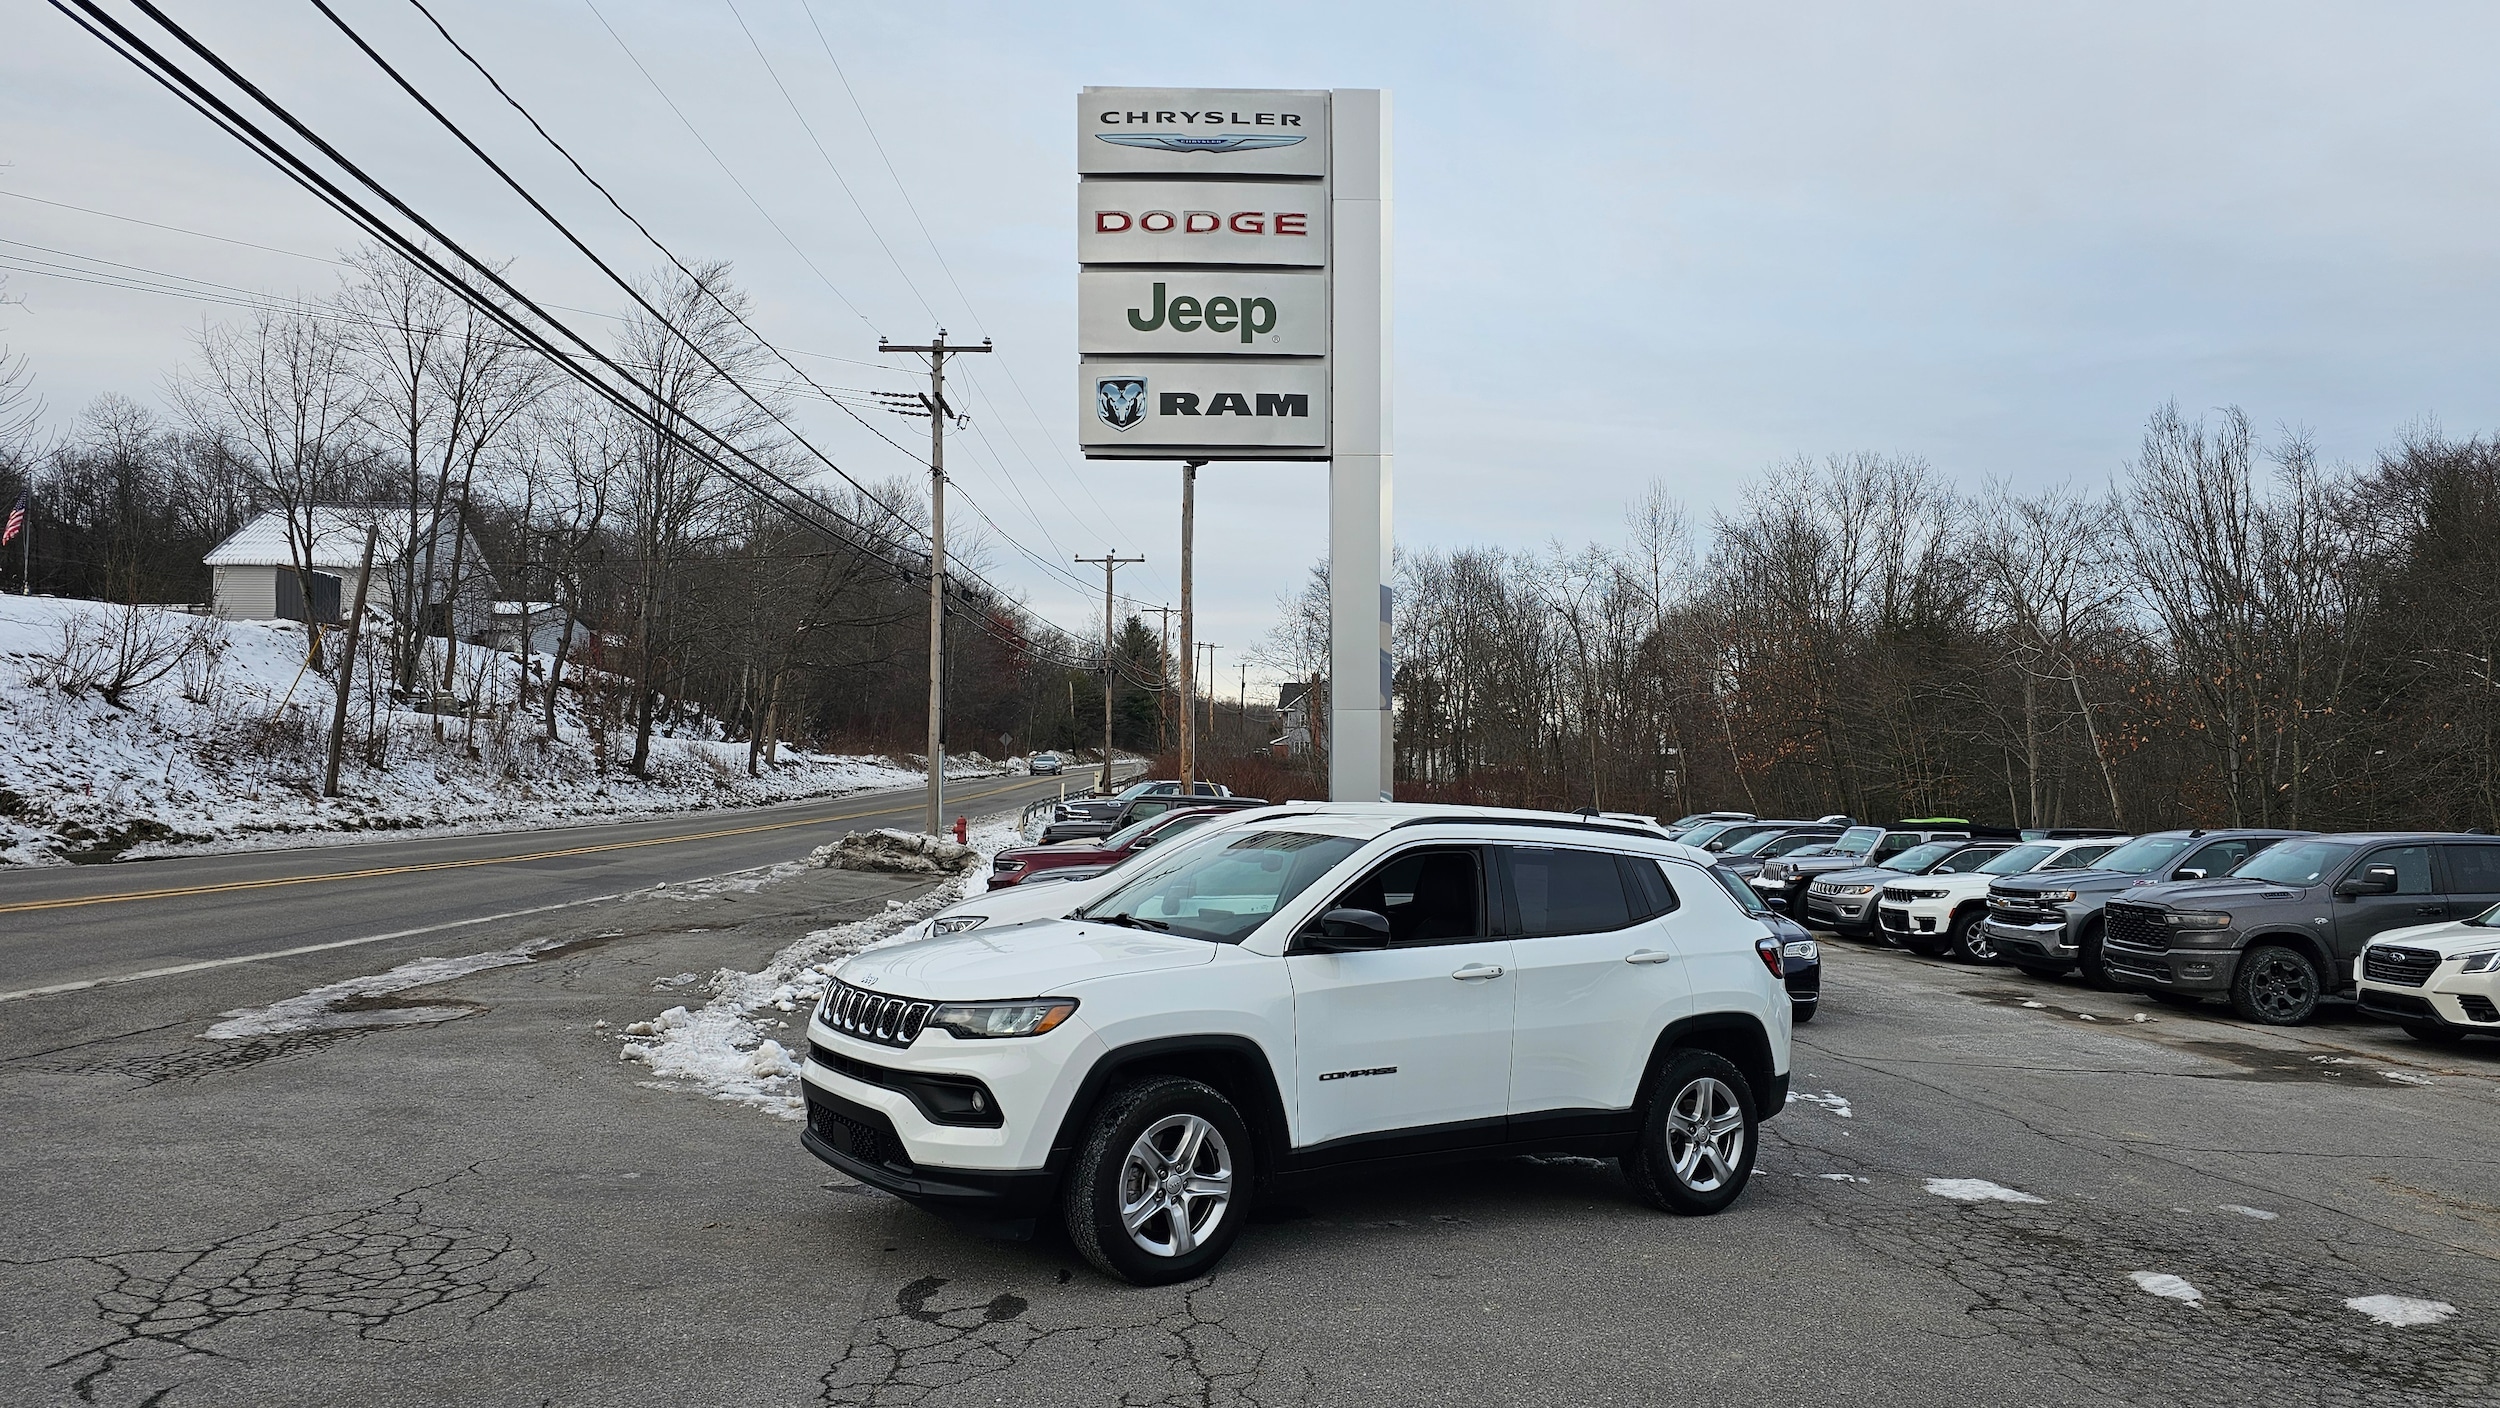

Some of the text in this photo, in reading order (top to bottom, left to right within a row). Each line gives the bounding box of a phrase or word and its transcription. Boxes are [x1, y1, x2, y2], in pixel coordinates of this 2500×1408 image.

[1100, 111, 1302, 127] CHRYSLER
[1095, 210, 1308, 236] DODGE
[1127, 282, 1277, 344] Jeep
[1159, 392, 1308, 418] RAM
[1318, 1066, 1398, 1081] COMPASS
